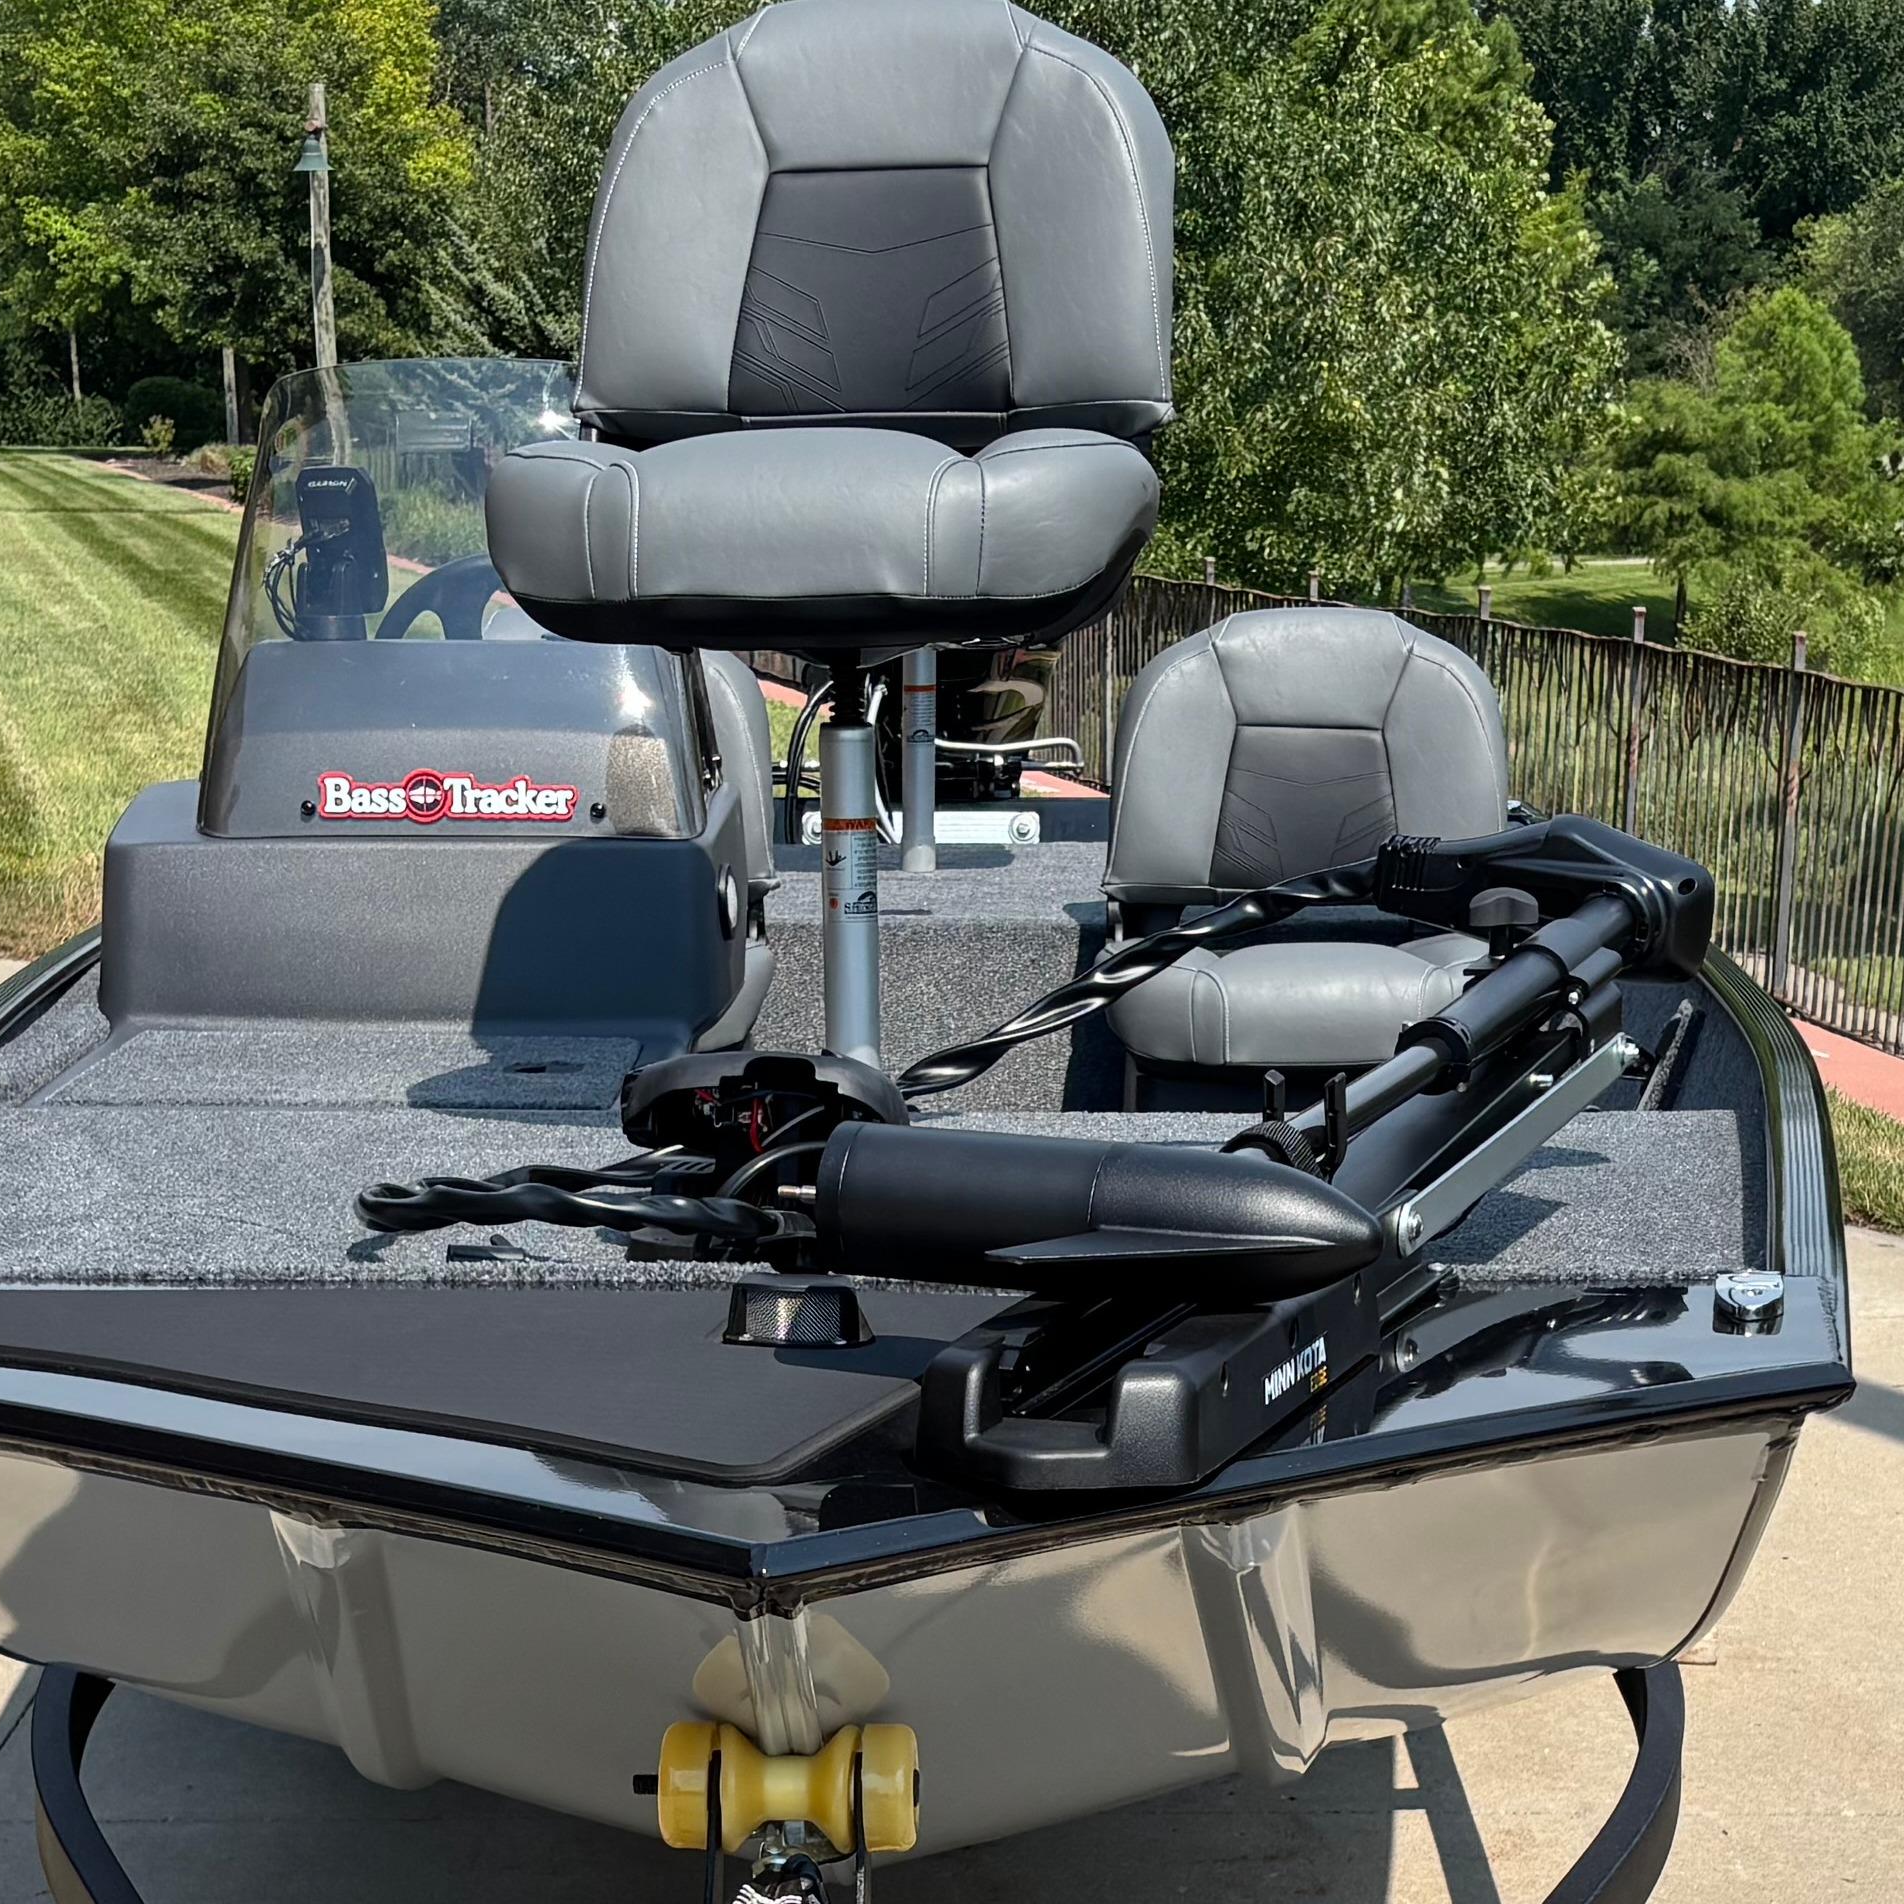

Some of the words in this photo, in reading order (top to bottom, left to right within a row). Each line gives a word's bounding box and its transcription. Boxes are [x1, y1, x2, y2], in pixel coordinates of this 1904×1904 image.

[323, 776, 407, 814] Bass
[443, 776, 574, 815] Tracker
[1264, 1357, 1296, 1405] MINN
[1296, 1336, 1327, 1382] KOTA
